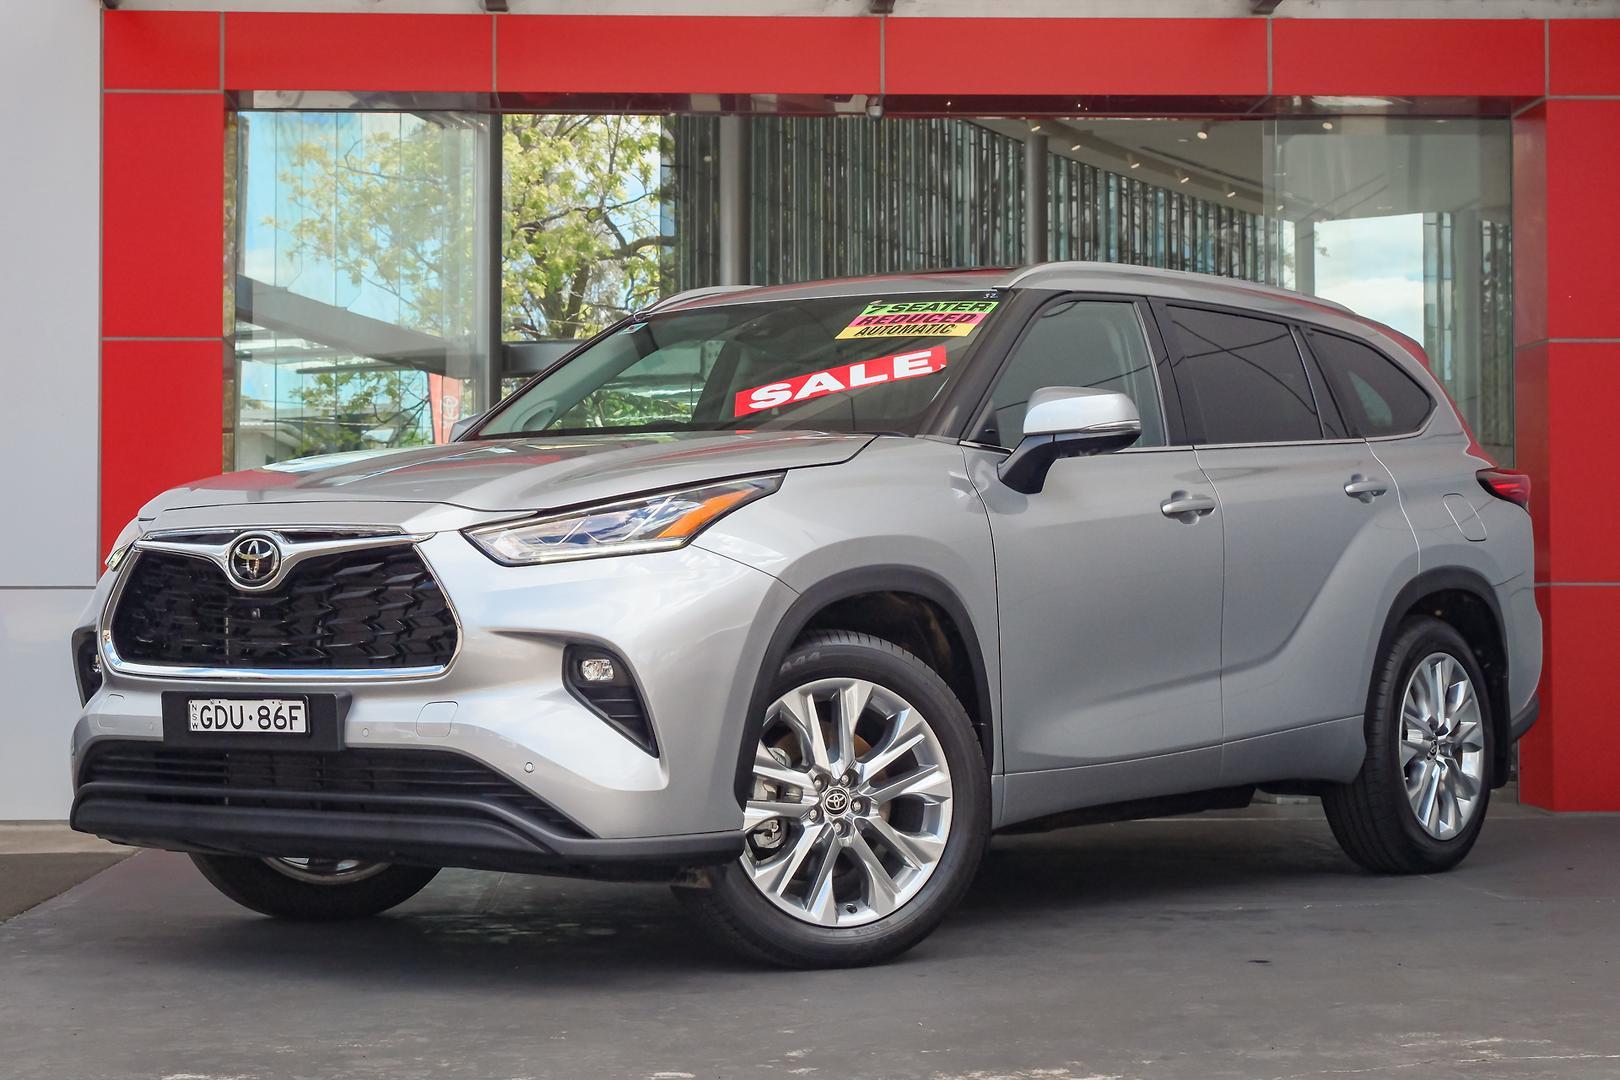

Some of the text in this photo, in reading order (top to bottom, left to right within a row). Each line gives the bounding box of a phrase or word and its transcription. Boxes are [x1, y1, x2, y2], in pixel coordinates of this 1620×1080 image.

[866, 302, 993, 315] 7 SEATER
[855, 313, 977, 326] REDUCED
[854, 324, 957, 336] AUTOMATIC
[748, 351, 933, 409] SALE
[191, 704, 199, 730] NSW
